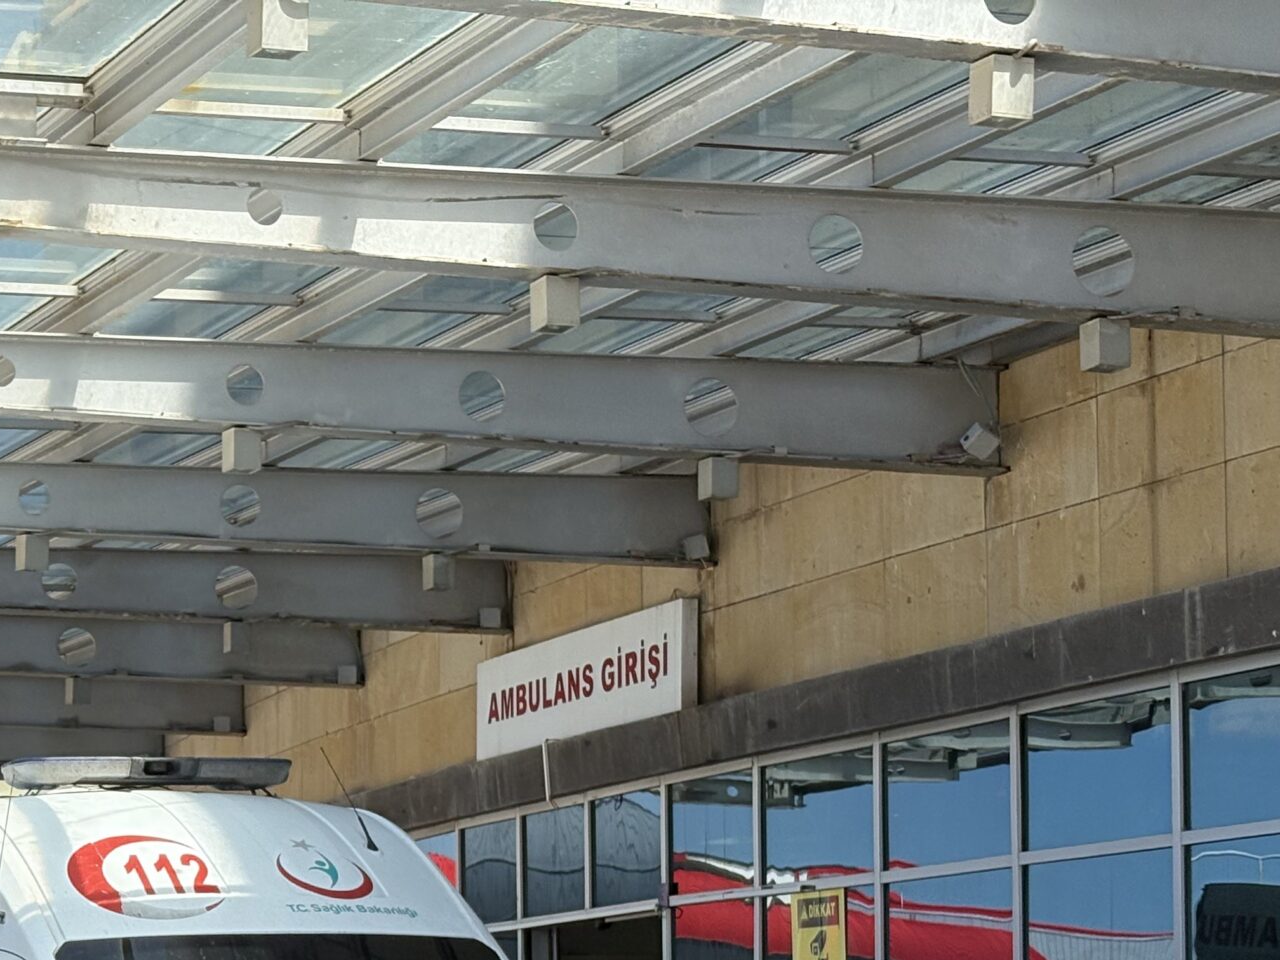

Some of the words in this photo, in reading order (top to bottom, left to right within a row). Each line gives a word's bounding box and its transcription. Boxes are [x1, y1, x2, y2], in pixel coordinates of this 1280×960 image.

[488, 664, 594, 724] AMBULANS
[601, 633, 668, 692] GİRİŞİ
[123, 853, 221, 895] 112
[312, 903, 354, 915] Sağlık
[356, 904, 419, 918] Bakanlığı
